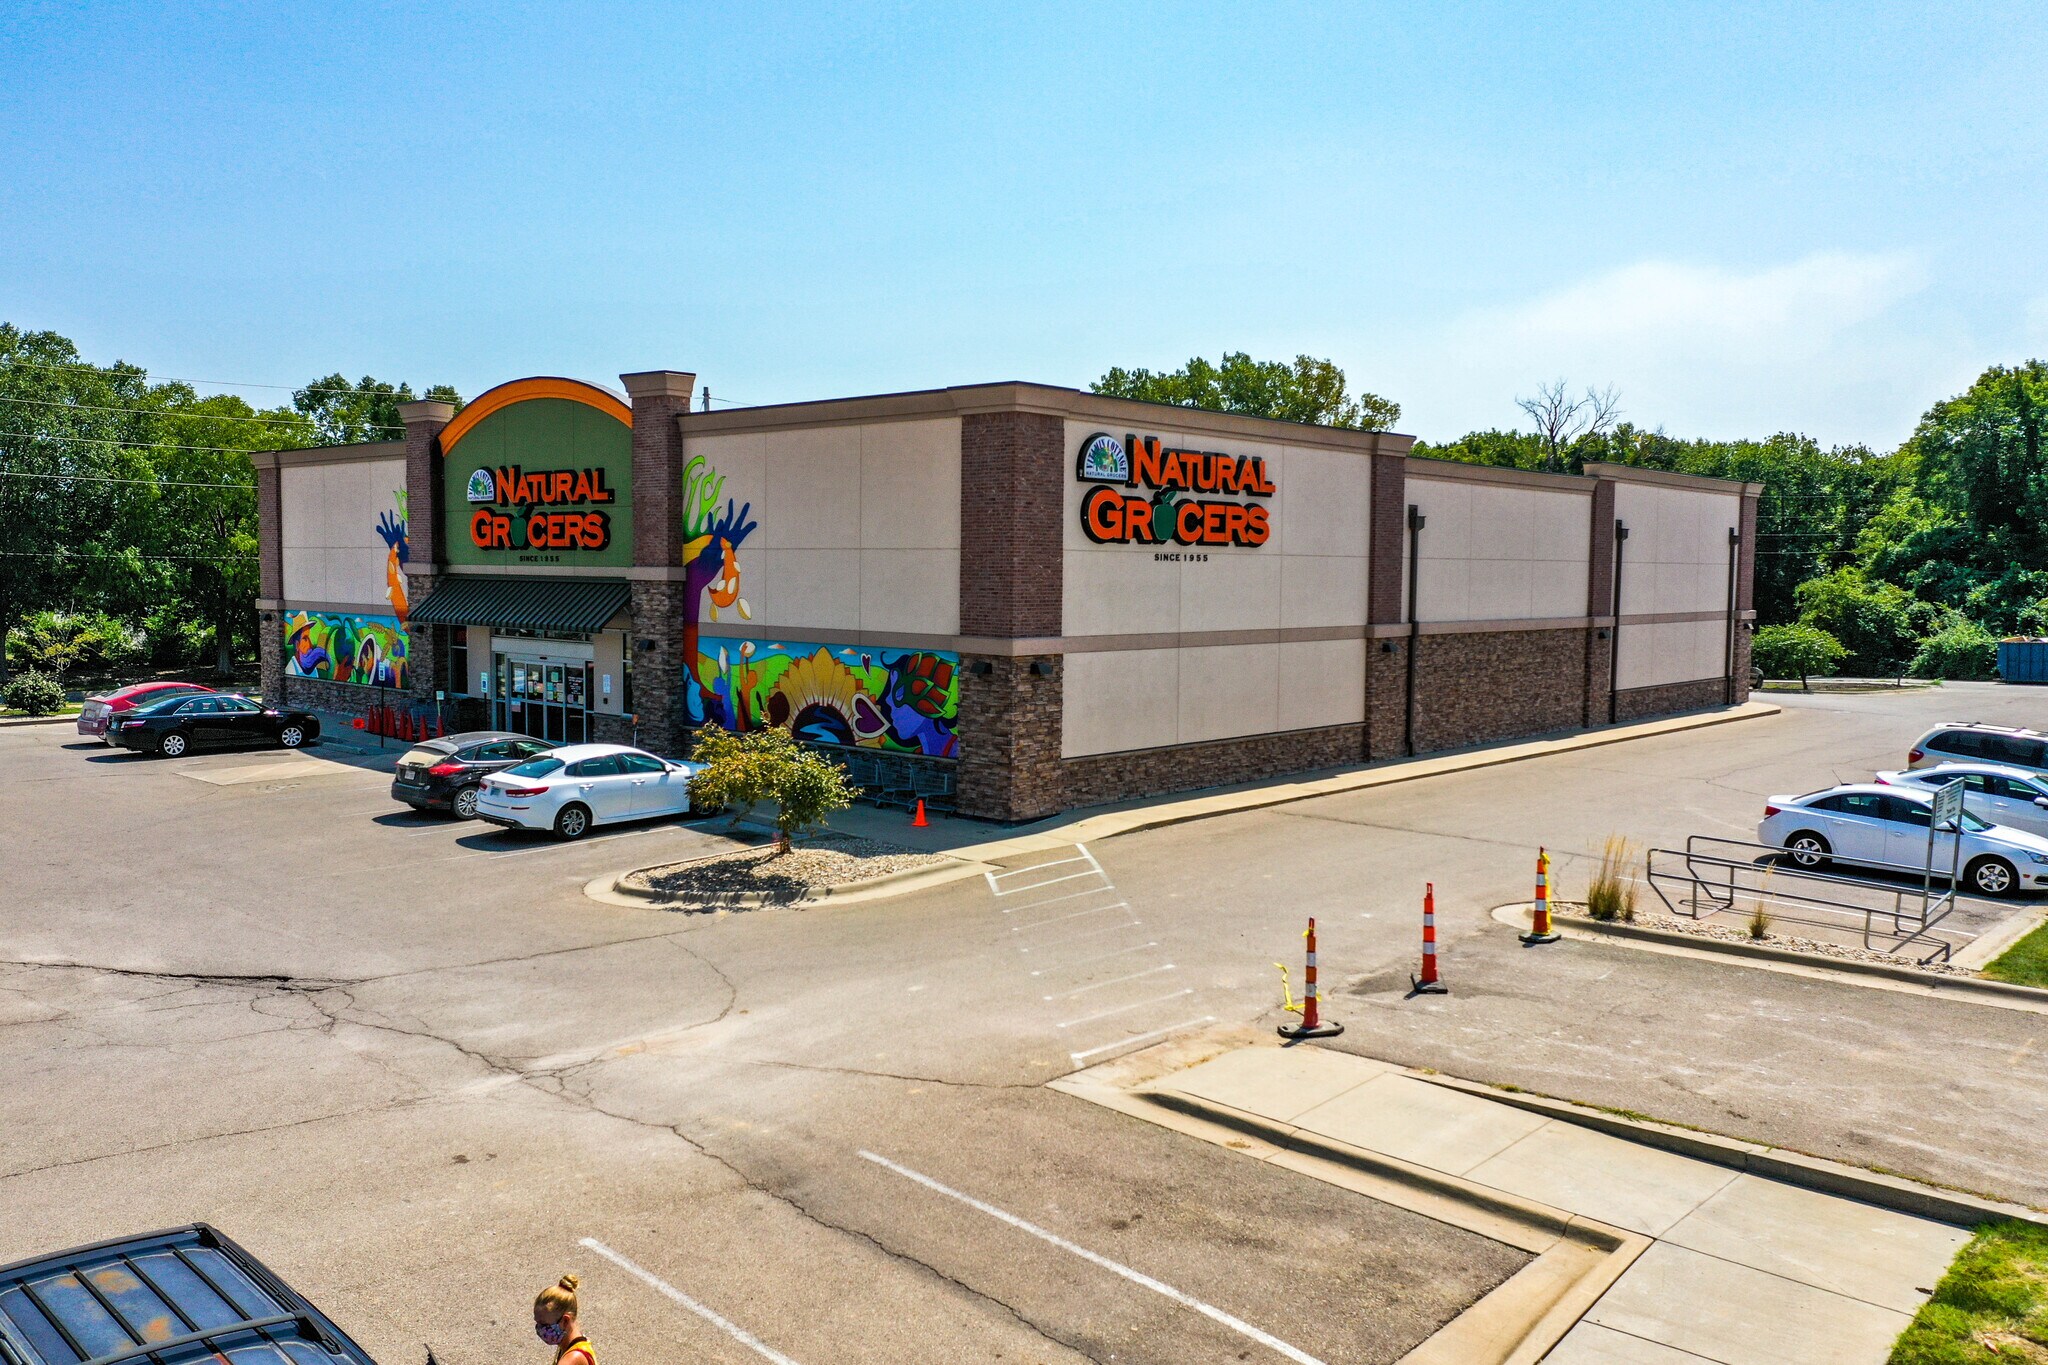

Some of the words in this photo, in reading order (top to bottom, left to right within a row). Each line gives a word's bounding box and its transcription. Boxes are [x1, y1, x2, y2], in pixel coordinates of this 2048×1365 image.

[1133, 438, 1276, 493] NATURAL
[496, 468, 609, 504] NATURAL
[470, 509, 605, 548] GROCERS
[1088, 489, 1270, 543] GROCERS
[1154, 553, 1180, 562] SINCE
[1183, 554, 1208, 562] 1955
